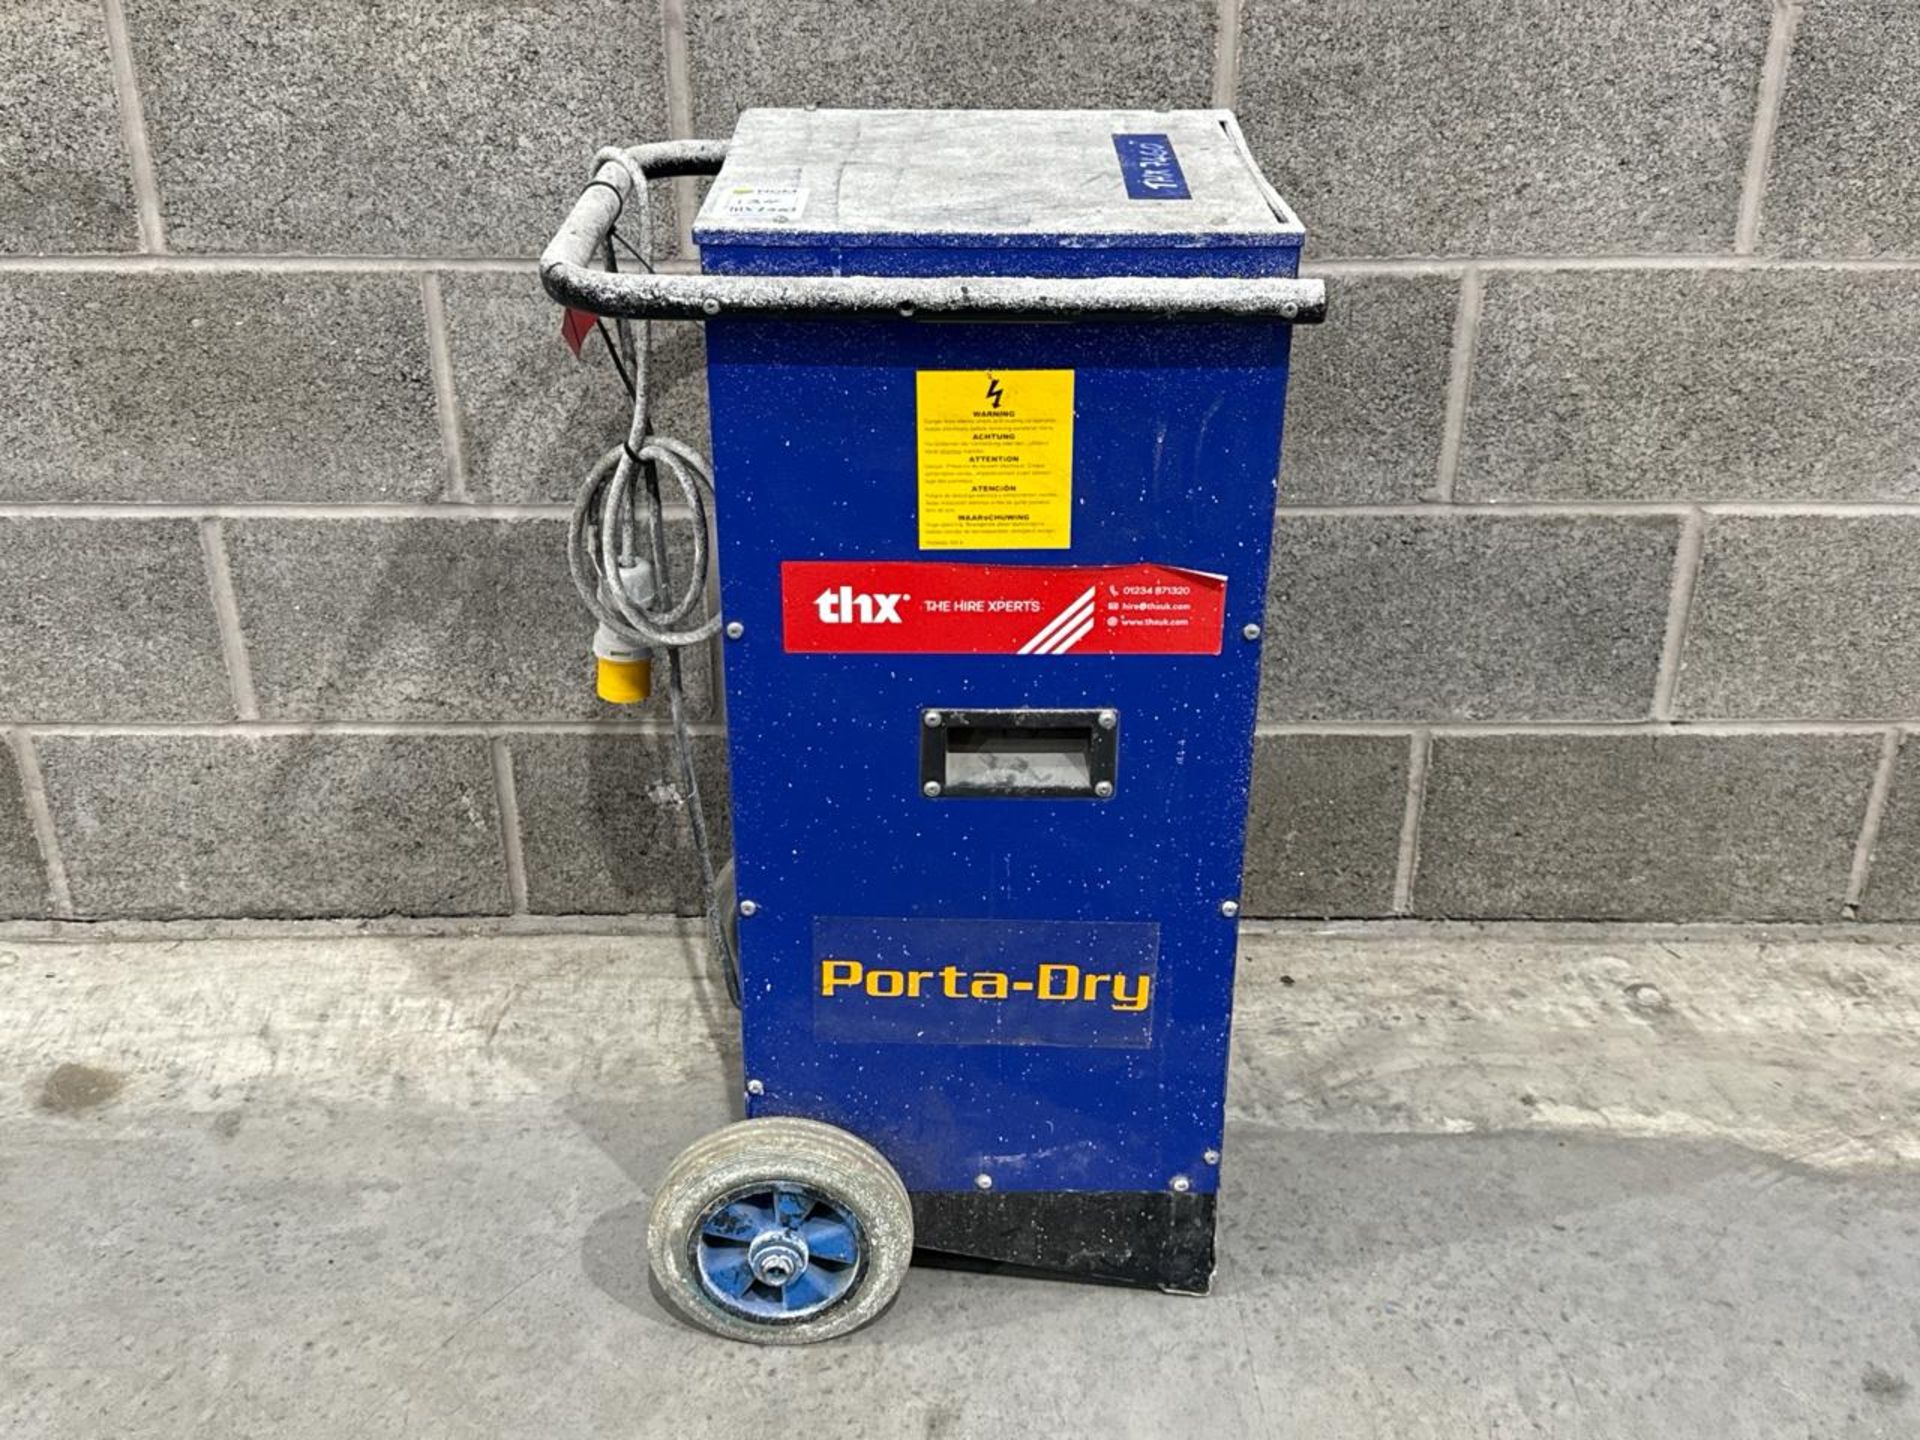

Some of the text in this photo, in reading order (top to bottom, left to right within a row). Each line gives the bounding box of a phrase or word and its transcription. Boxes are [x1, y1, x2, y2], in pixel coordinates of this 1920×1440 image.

[973, 410, 1016, 418] WARNING
[1123, 586, 1153, 595] 01234
[813, 585, 1041, 624] thx THE HIRE XPERTS
[821, 960, 1150, 1011] Porta-Dry
